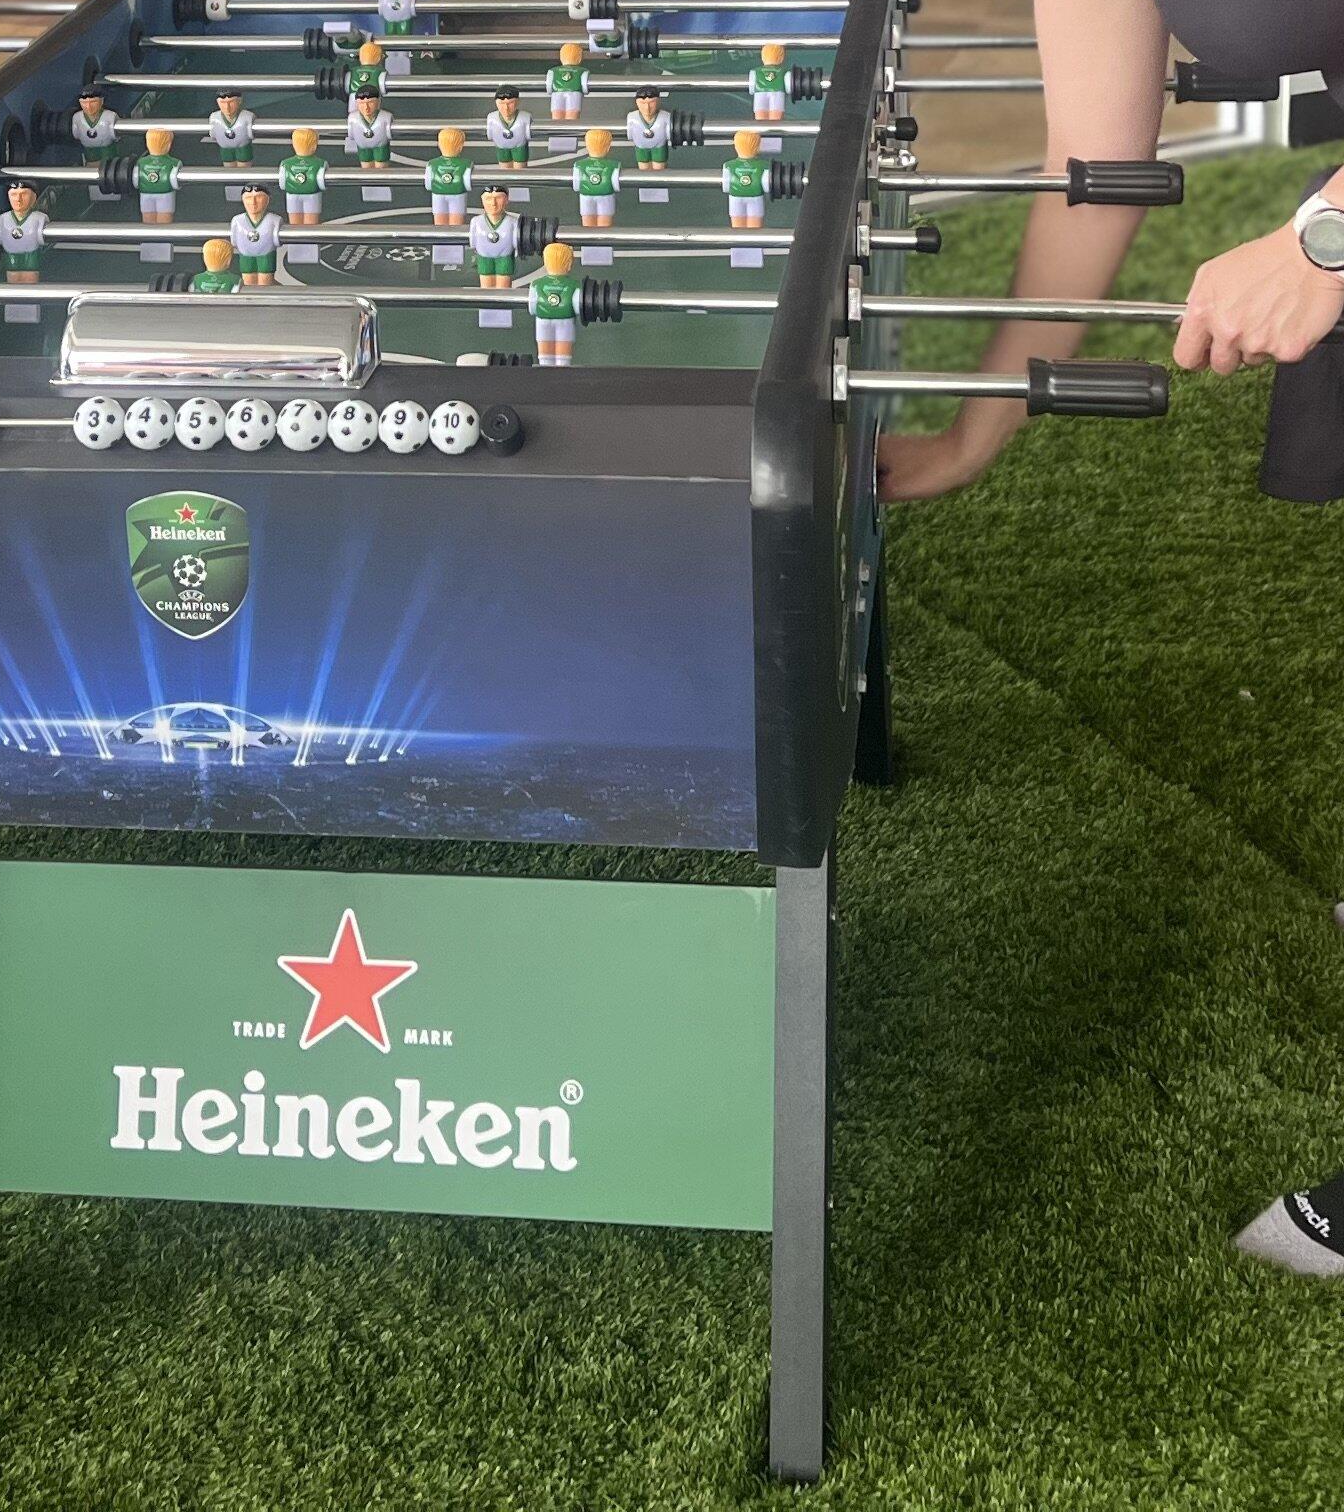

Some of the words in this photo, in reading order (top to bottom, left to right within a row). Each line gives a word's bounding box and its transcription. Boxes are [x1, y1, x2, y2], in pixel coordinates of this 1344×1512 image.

[87, 410, 100, 428] 3
[138, 407, 151, 423] 4
[189, 411, 202, 429] 5
[240, 406, 253, 423] 6
[294, 403, 307, 418] 7
[343, 405, 355, 421] 8
[394, 409, 407, 425] 9
[442, 412, 460, 429] 10
[149, 525, 226, 542] Heineken
[156, 600, 230, 613] CHAMPIONS
[174, 611, 213, 621] LEAGUE
[232, 1021, 286, 1039] TRADE
[403, 1028, 454, 1047] MARK
